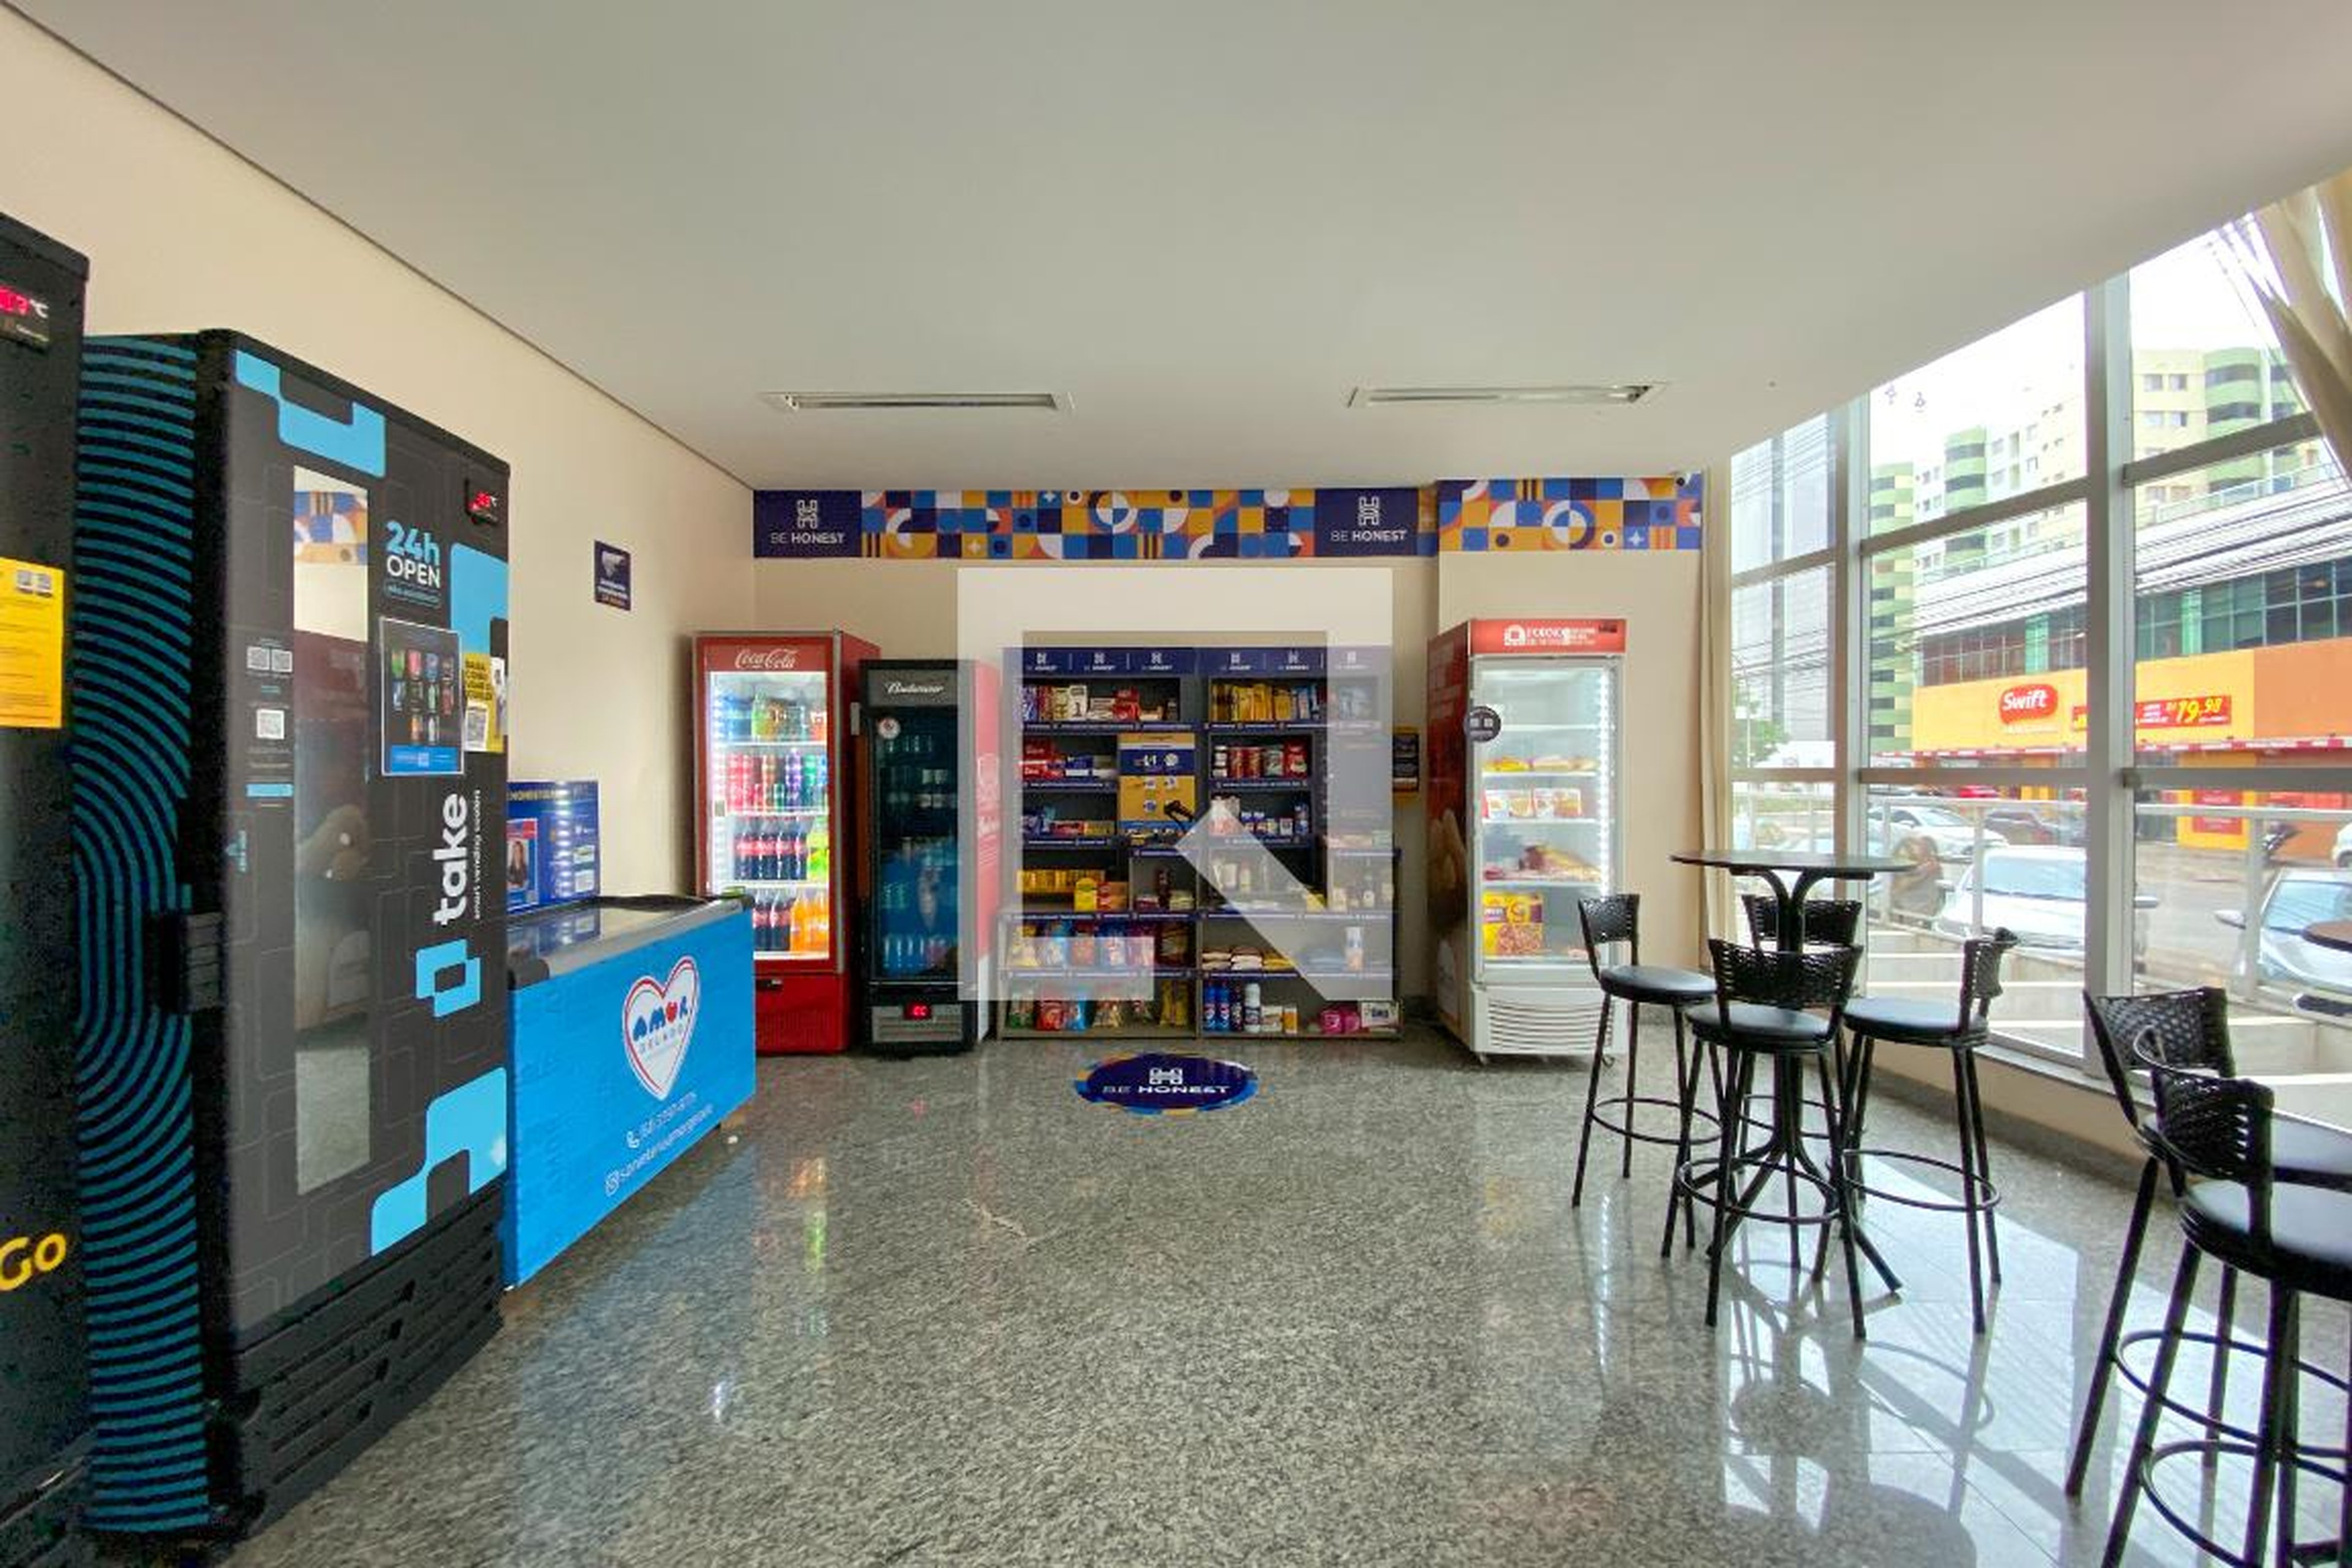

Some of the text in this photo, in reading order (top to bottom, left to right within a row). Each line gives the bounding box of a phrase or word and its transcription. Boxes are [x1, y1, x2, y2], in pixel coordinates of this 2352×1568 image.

[386, 521, 440, 566] 24h
[770, 532, 845, 544] BE HONEST
[1330, 529, 1408, 542] BE HONEST
[386, 554, 440, 589] OPEN
[2001, 688, 2048, 712] Swift
[432, 793, 467, 925] take
[1138, 1085, 1231, 1094] HONEST
